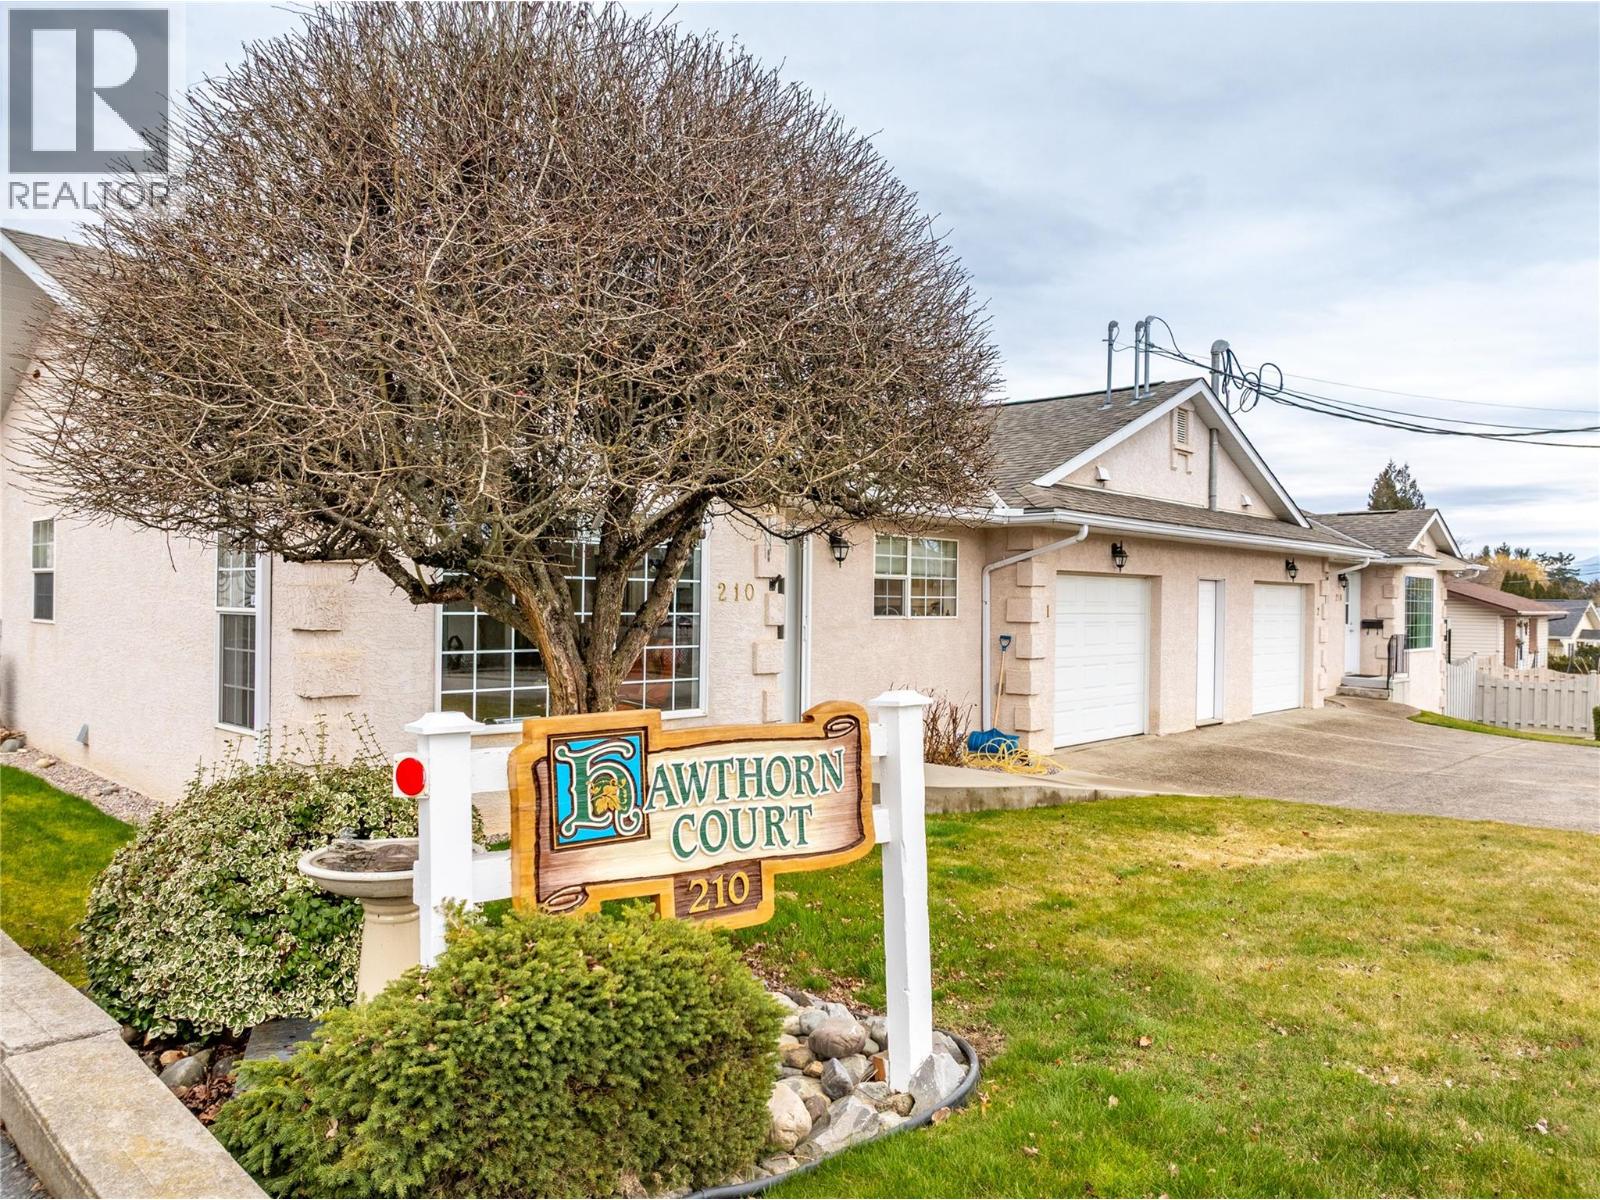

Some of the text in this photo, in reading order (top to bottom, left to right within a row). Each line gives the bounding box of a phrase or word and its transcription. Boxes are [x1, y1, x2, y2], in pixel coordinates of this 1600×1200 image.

[717, 582, 755, 602] 210
[670, 803, 814, 862] COURT
[687, 870, 750, 914] 210
